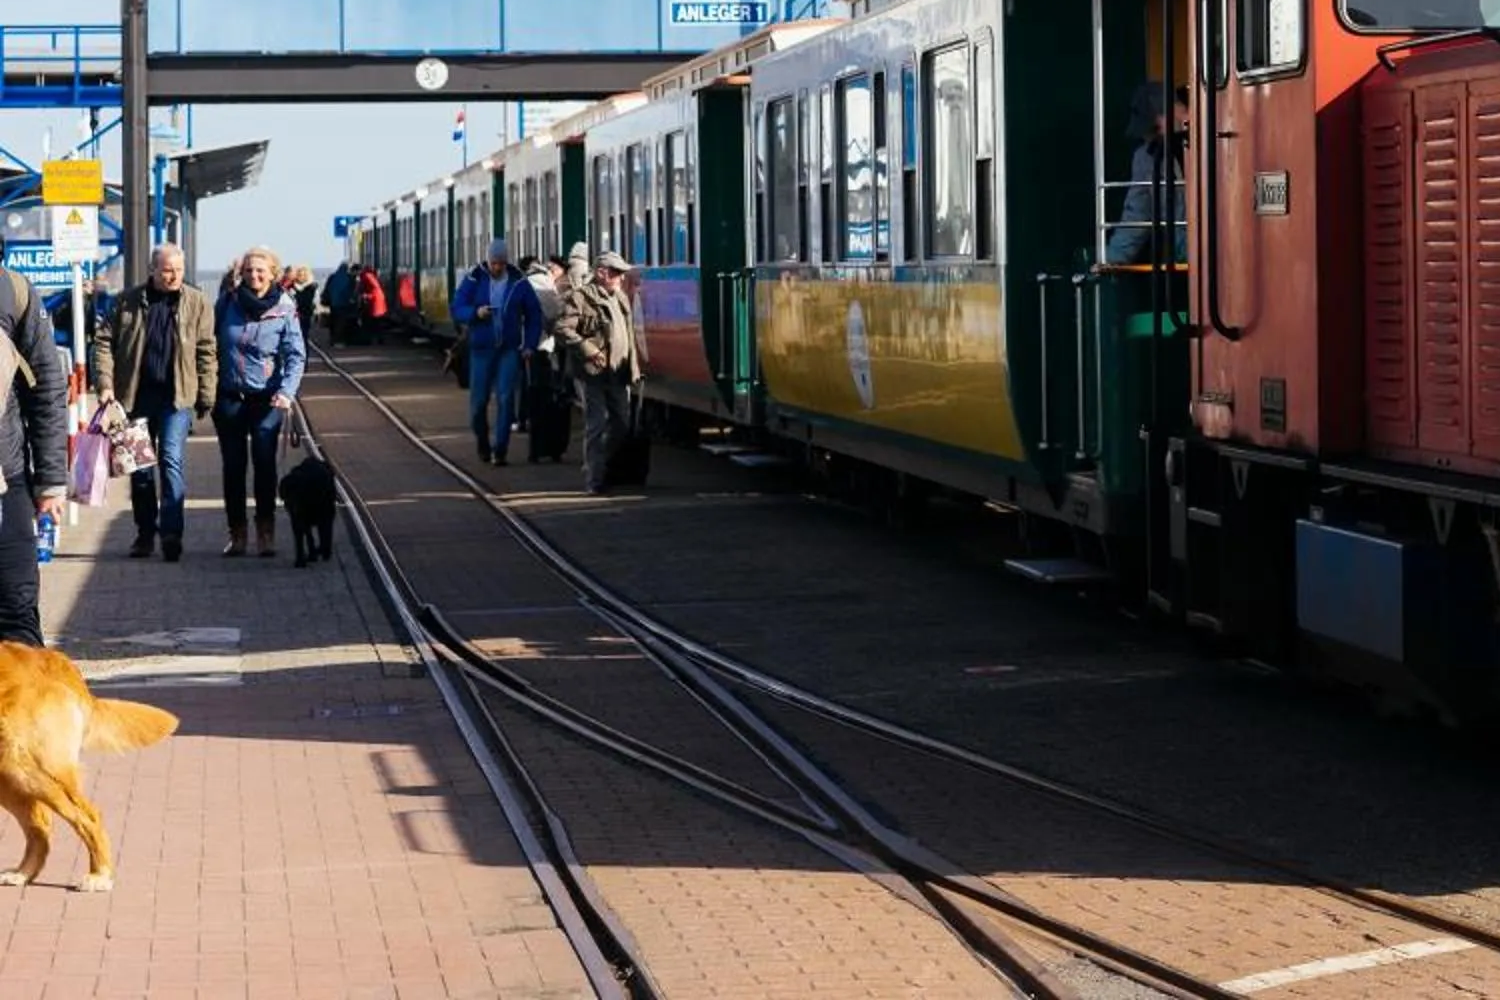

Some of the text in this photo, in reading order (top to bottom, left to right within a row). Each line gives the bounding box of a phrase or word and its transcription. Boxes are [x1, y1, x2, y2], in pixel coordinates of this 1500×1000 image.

[677, 4, 765, 21] ANLEGER 1
[8, 250, 72, 267] ANLEG
